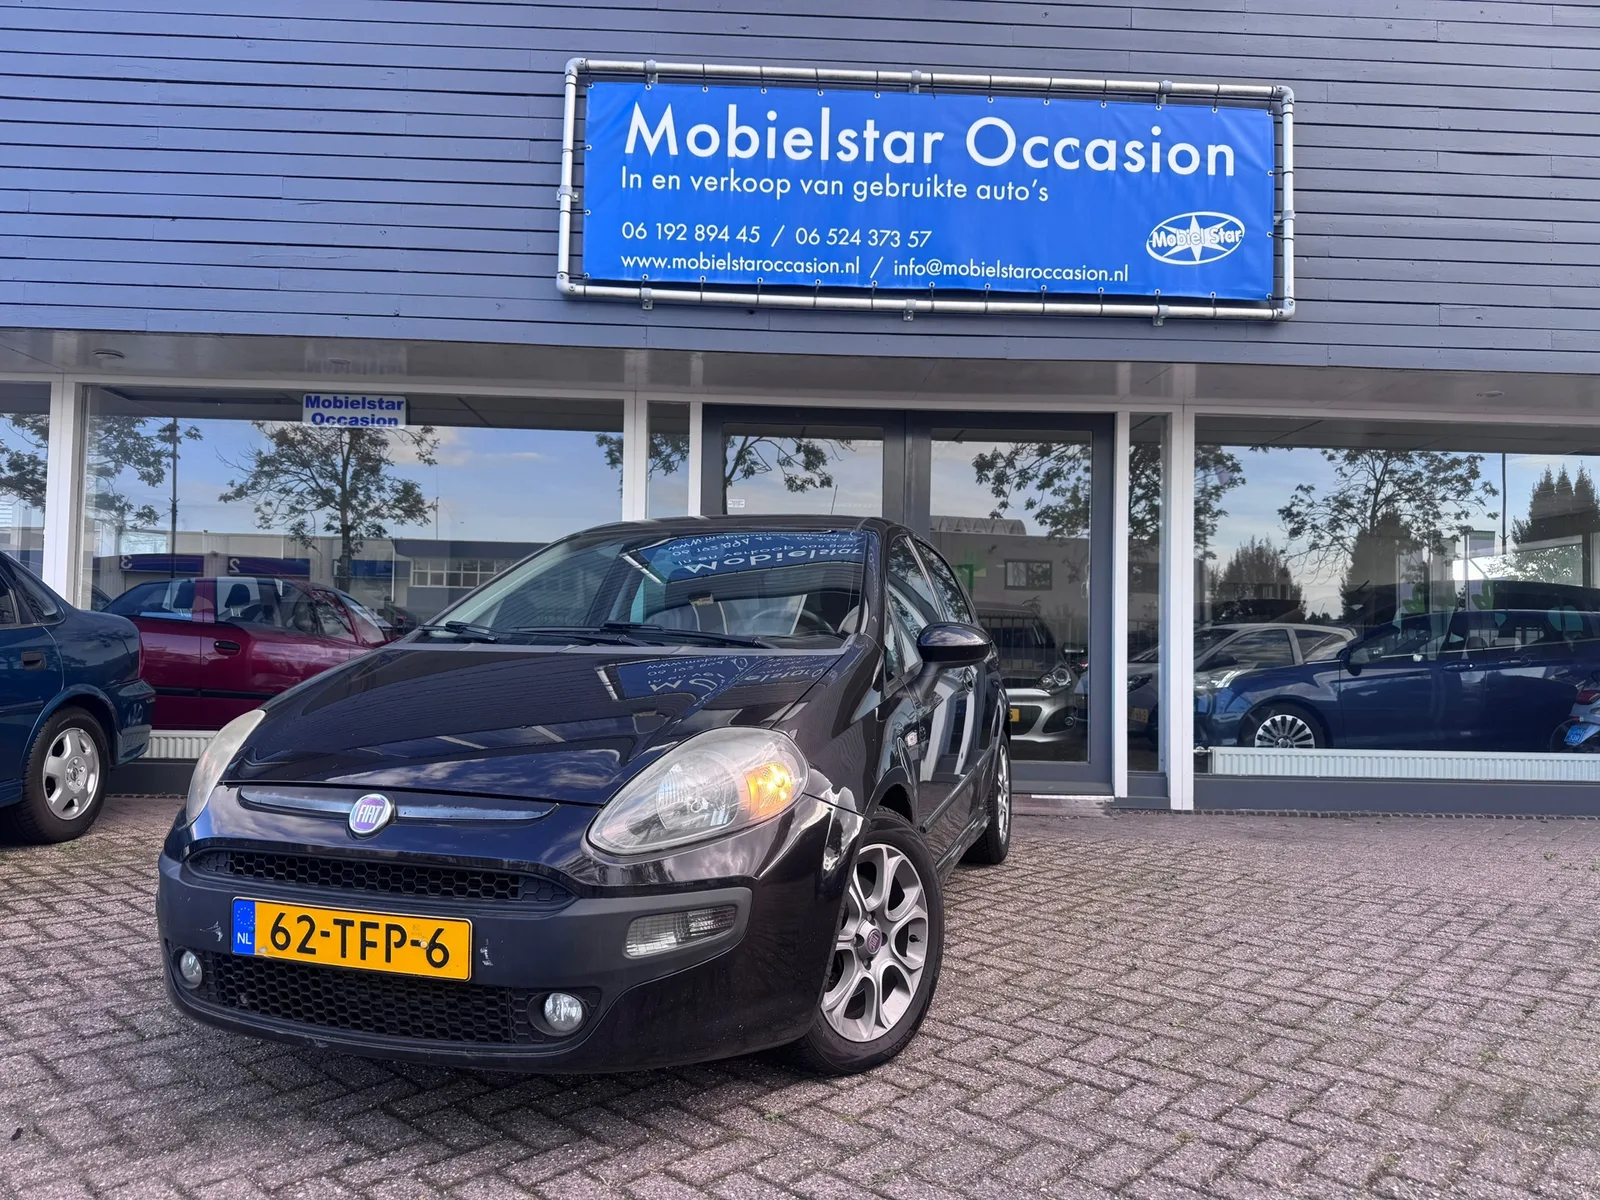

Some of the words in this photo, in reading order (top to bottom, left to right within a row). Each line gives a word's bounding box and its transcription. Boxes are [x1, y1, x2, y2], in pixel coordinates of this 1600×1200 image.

[625, 101, 944, 164] Mobielstar
[966, 116, 1234, 177] Occasion
[621, 165, 642, 189] In
[652, 174, 681, 190] en
[690, 167, 791, 200] verkoop
[800, 178, 843, 196] van
[853, 172, 967, 202] gebruikte
[621, 222, 648, 240] 06
[655, 223, 687, 241] 192
[694, 224, 730, 243] 894
[735, 225, 761, 244] 45
[771, 224, 786, 247] /
[795, 227, 821, 246] 06
[826, 228, 861, 246] 524
[867, 229, 901, 247] 373
[907, 230, 933, 248] 57
[1152, 227, 1206, 248] Mobiel
[1209, 226, 1243, 244] Star
[620, 251, 860, 275] www.mobielstaroccasion.nl
[869, 256, 884, 279] /
[893, 258, 1129, 282] info@mobielstaroccasion.nl
[305, 395, 404, 411] Mobielstar
[311, 412, 399, 427] Occasion
[356, 804, 383, 824] FIAT
[237, 932, 252, 945] NL
[270, 912, 450, 968] 62-TFP-6
